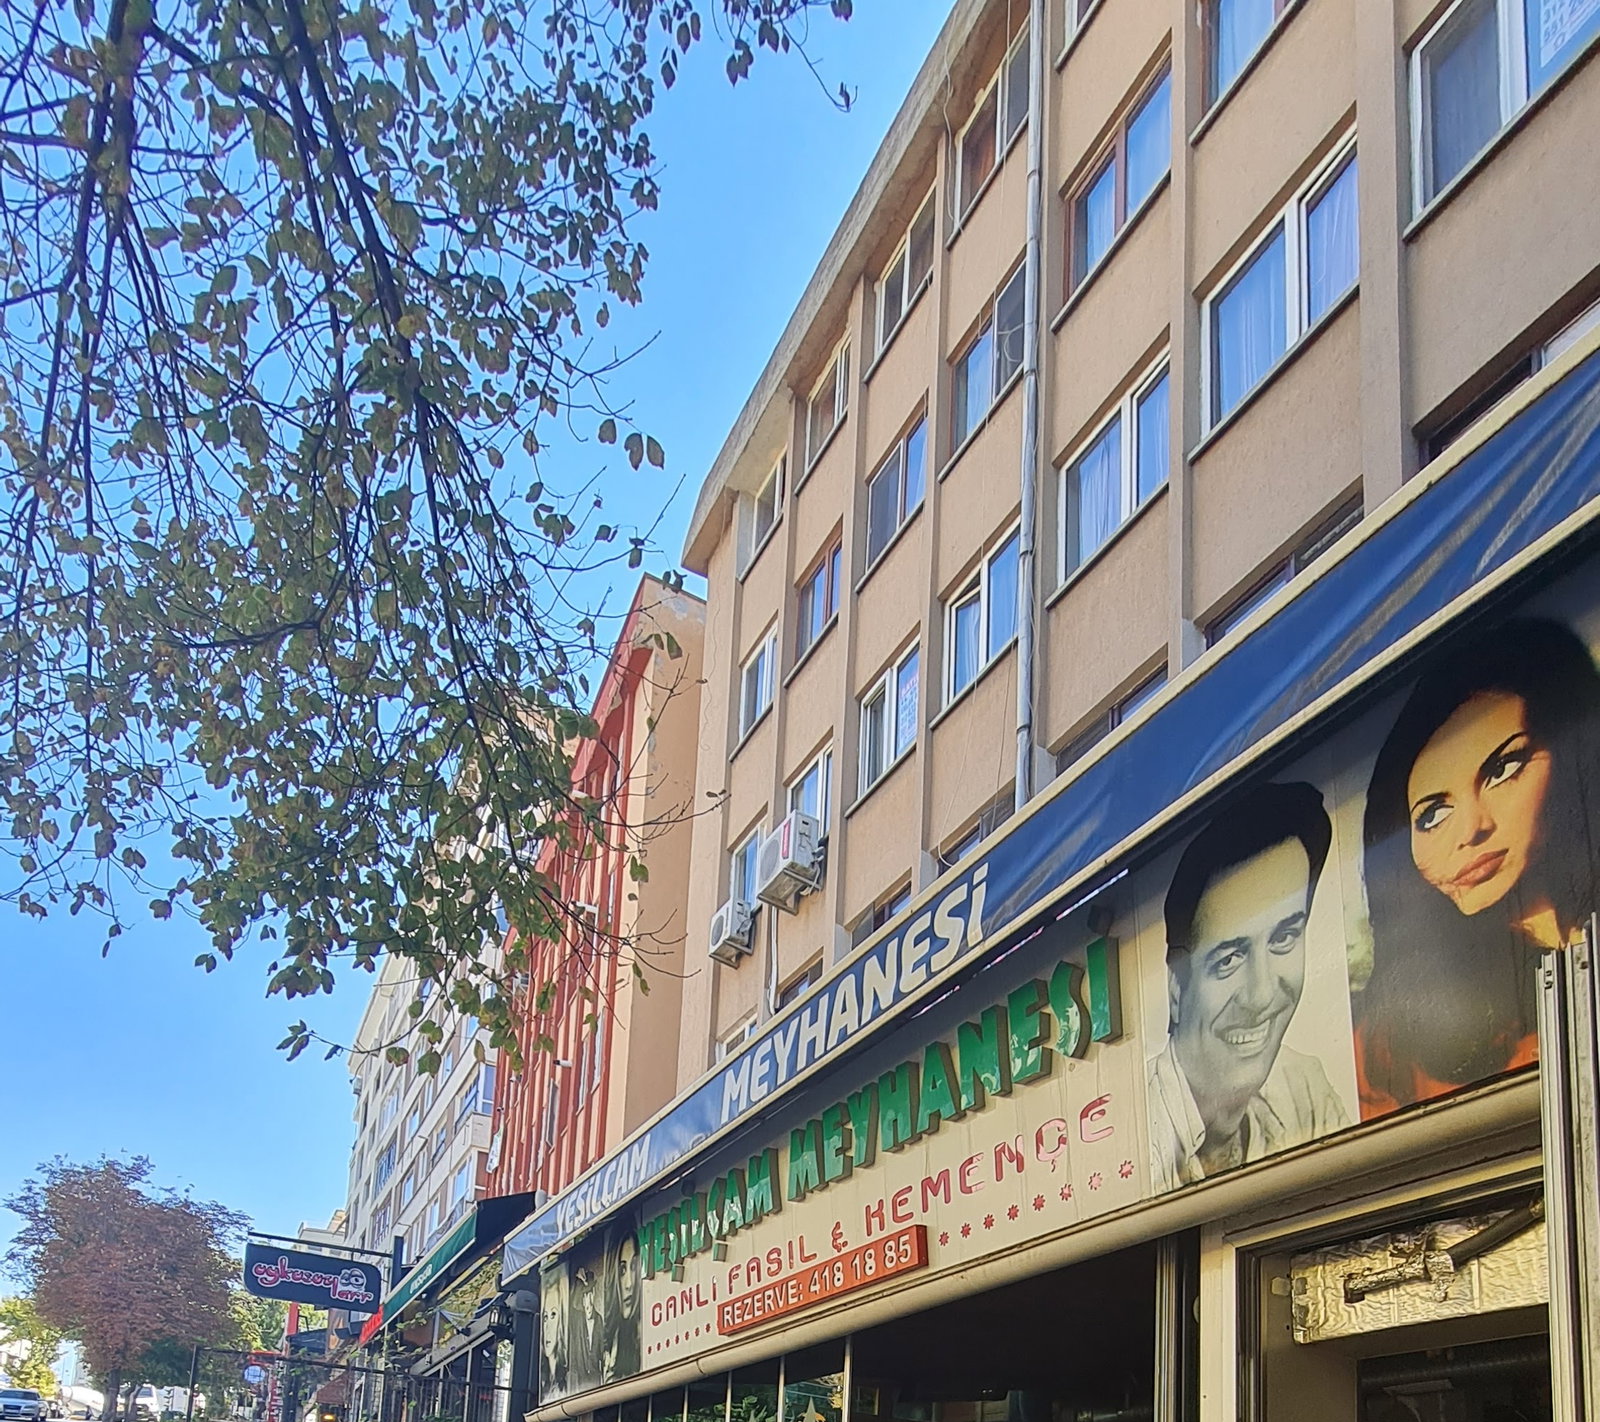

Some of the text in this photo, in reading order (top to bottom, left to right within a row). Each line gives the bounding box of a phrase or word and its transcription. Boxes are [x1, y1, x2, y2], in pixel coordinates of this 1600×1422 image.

[720, 862, 989, 1125] MEYHANESİ
[723, 1234, 912, 1329] REZERVE: 418 18 85
[728, 1235, 817, 1295] FASIL
[865, 1092, 1115, 1237] KEMENÇE
